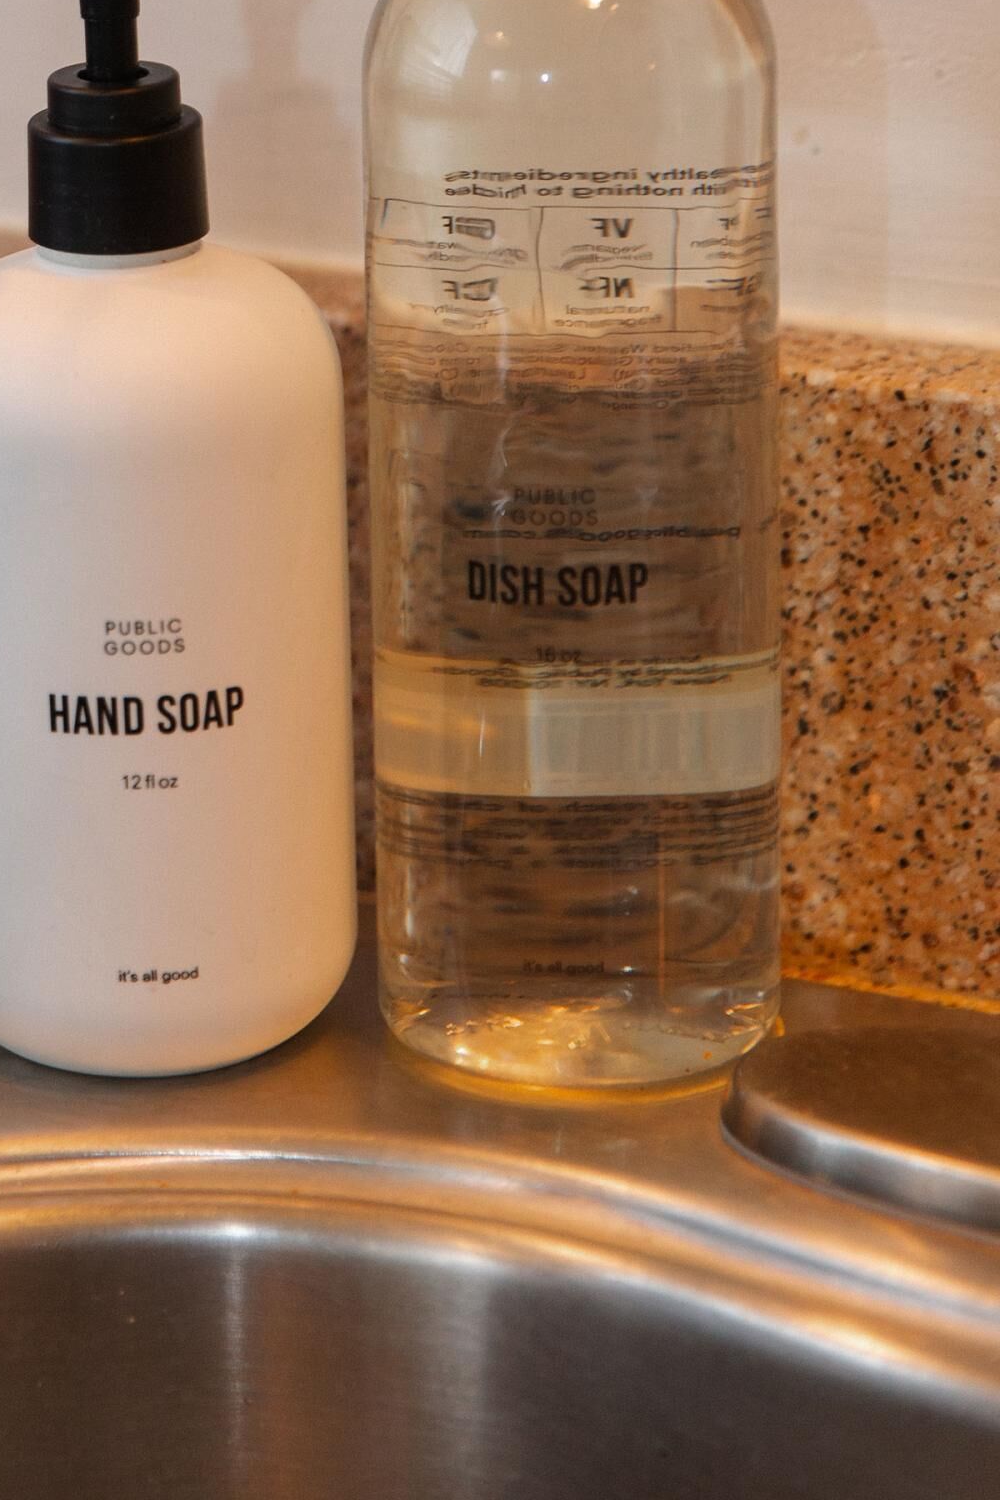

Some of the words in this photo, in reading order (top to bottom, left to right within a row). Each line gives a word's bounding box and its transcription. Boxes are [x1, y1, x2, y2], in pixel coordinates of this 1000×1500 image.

[513, 487, 597, 506] PUBLIC
[510, 507, 600, 527] GOODS
[467, 559, 546, 606] DISH
[556, 561, 649, 607] SOAP
[104, 617, 183, 636] PUBLIC
[103, 637, 186, 656] GOODS
[48, 693, 145, 736] HAND
[157, 686, 245, 735] SOAP
[122, 774, 142, 790] 12
[145, 773, 156, 789] fl
[158, 775, 180, 789] oz
[118, 969, 139, 982] it's
[142, 969, 158, 982] all
[161, 966, 199, 984] good
